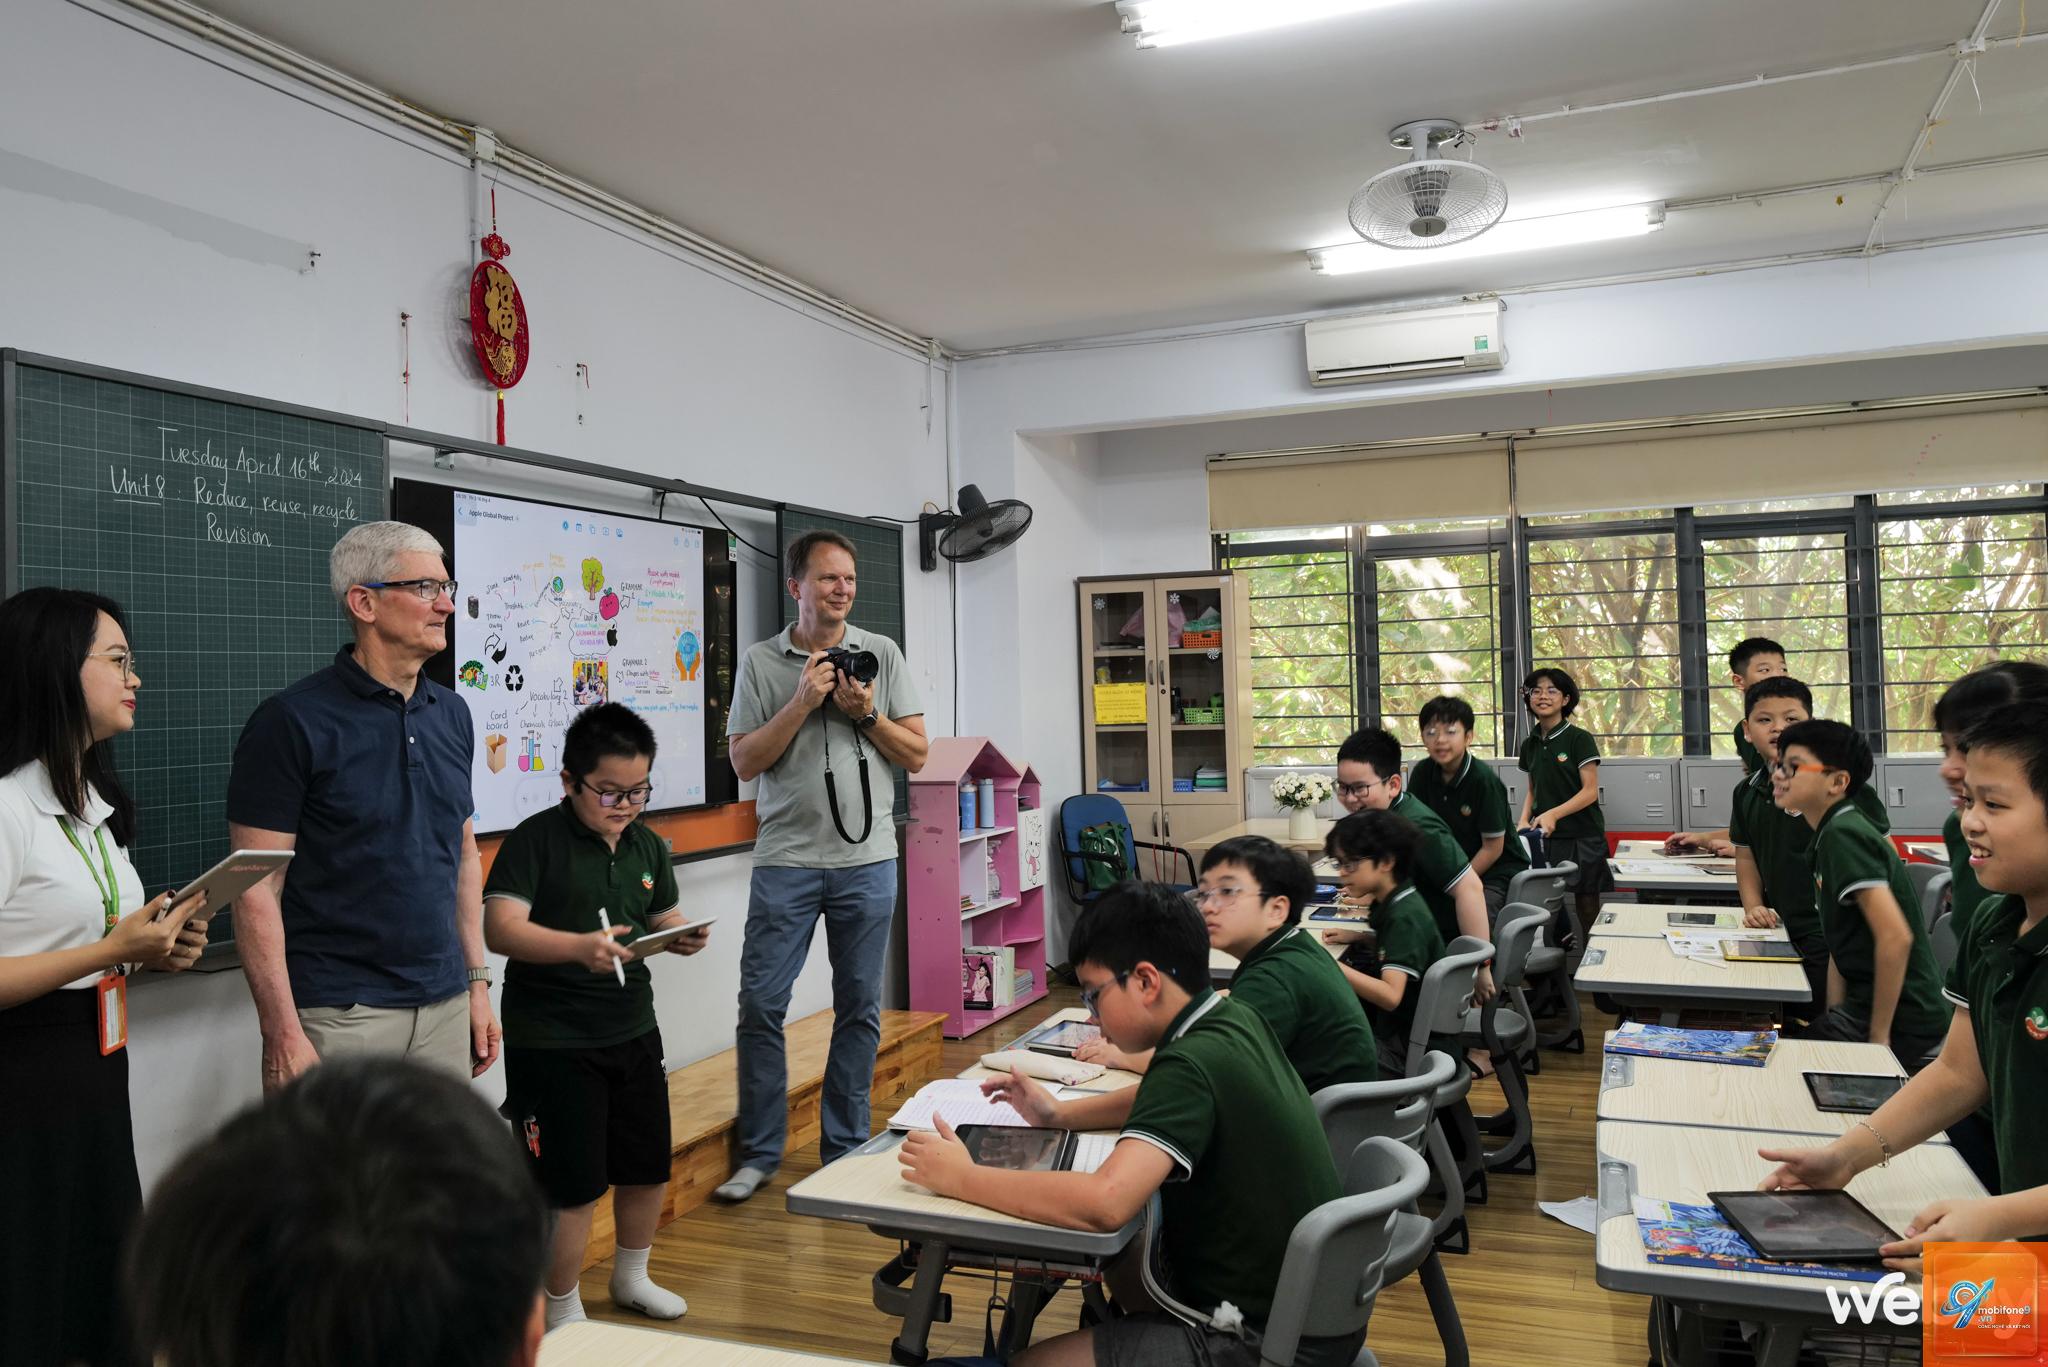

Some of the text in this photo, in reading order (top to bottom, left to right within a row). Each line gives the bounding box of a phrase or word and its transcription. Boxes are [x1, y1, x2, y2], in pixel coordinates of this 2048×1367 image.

[157, 426, 228, 486] Tuesday
[236, 446, 281, 484] April
[111, 465, 150, 497] Unit
[194, 476, 253, 515] Reduce,
[263, 496, 306, 519] reuse,
[313, 496, 359, 528] recycle
[469, 509, 514, 522] Apple Global Project
[206, 512, 272, 548] Revision
[490, 674, 501, 687] 3R
[486, 720, 509, 731] board
